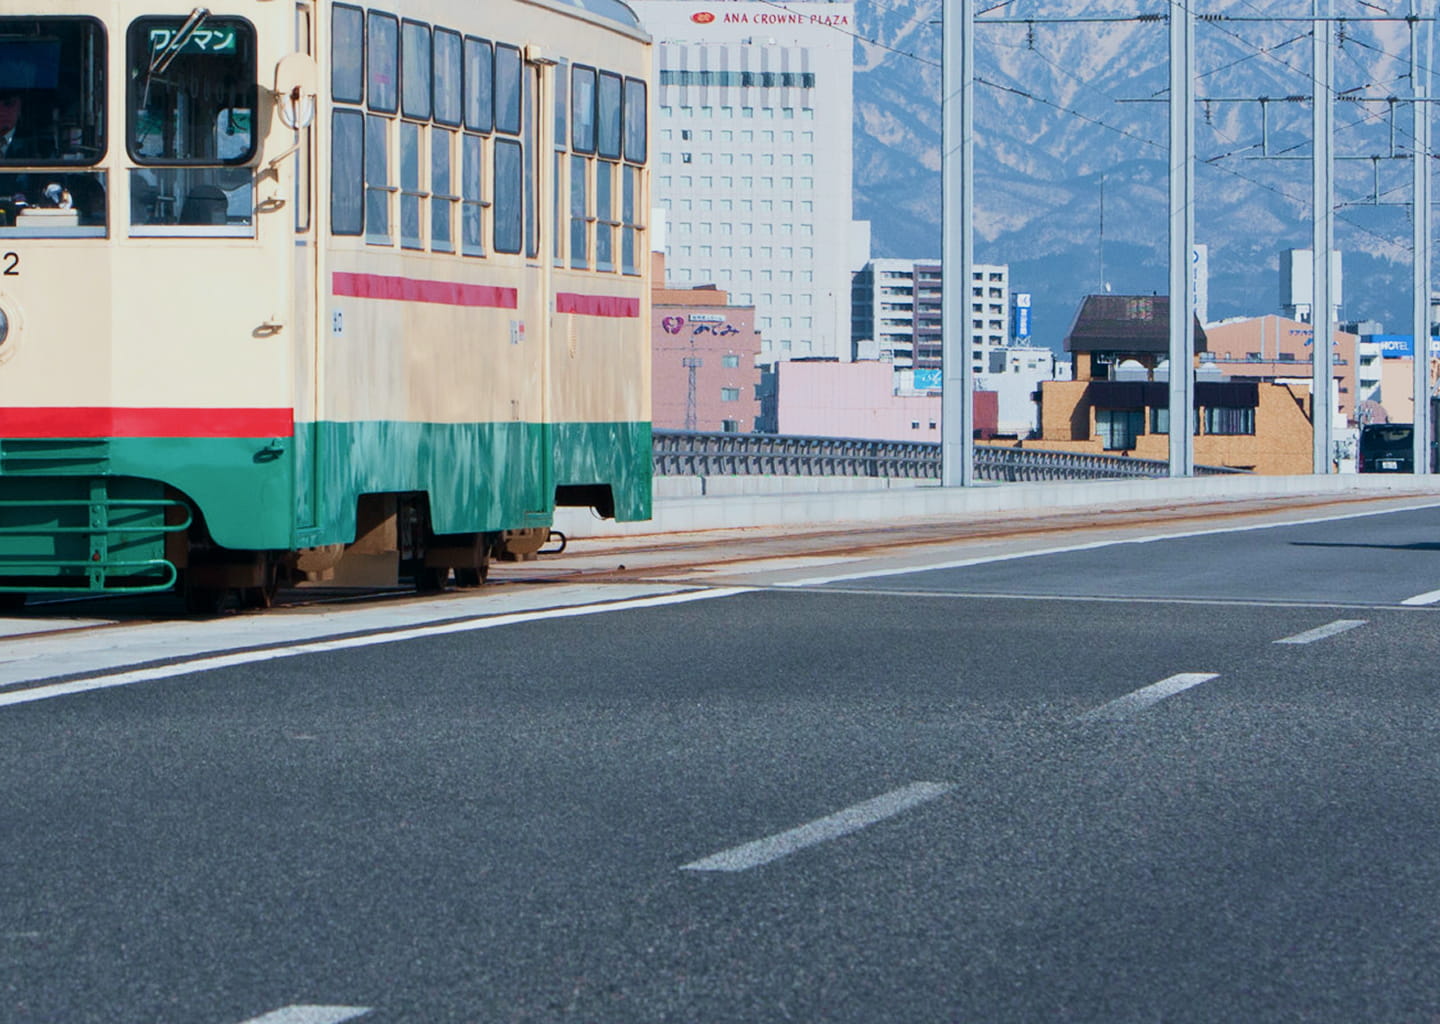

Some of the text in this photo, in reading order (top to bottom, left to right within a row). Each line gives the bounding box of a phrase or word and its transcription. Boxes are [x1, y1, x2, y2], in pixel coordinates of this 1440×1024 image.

[723, 13, 849, 26] ANA CROWNE PLAZA
[1381, 340, 1409, 351] HOTEL
